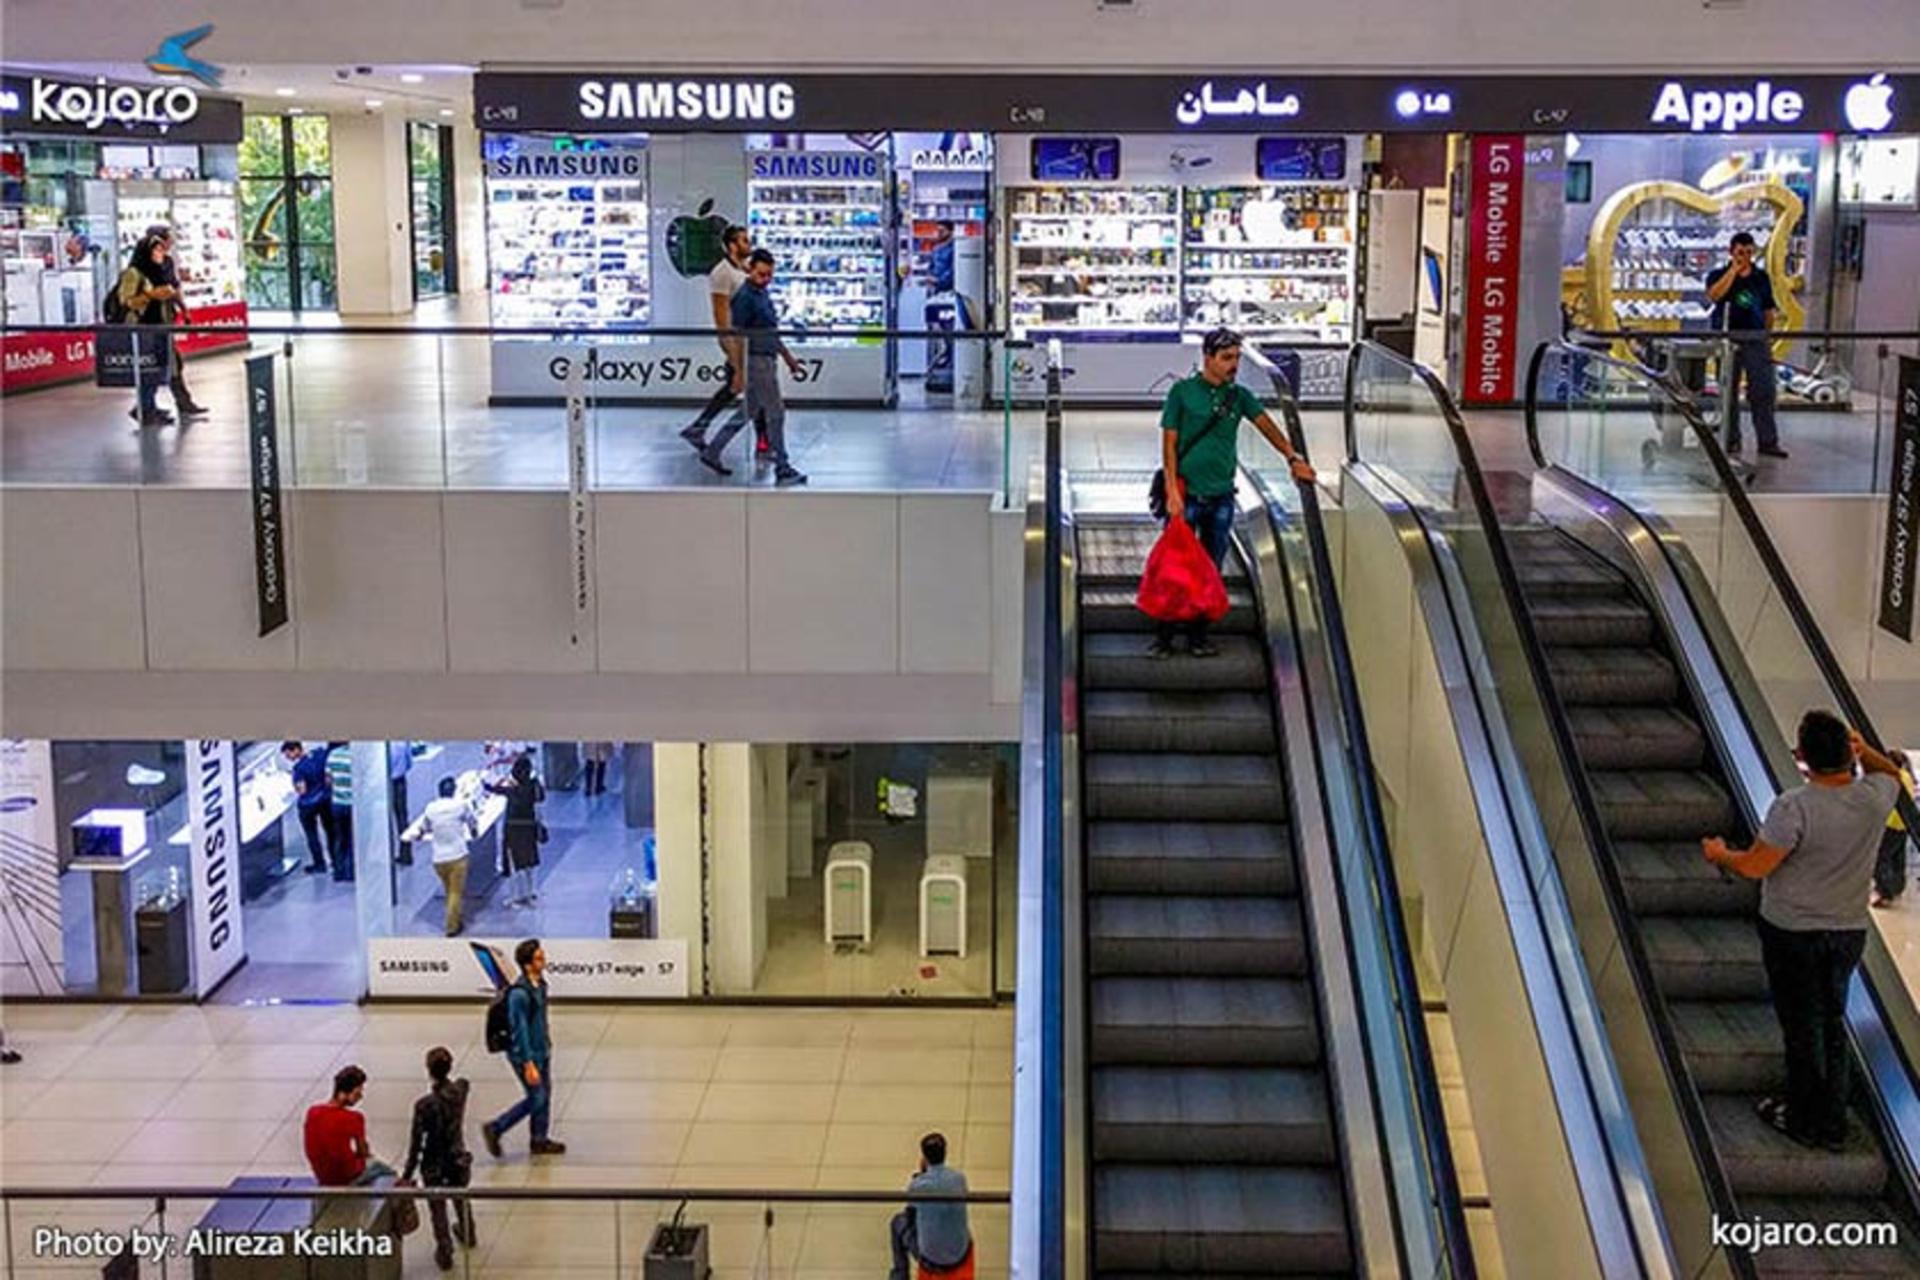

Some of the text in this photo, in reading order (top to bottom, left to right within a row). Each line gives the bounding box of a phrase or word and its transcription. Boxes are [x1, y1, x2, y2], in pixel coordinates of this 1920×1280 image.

[580, 82, 795, 120] SAMSUNG
[1176, 83, 1299, 124] ماهان
[1652, 83, 1803, 131] Apple
[497, 155, 639, 175] SAMSUNG
[754, 156, 877, 176] SAMSUNG
[1480, 144, 1510, 394] LG Mobile LG Mobile
[5, 350, 55, 372] Mobile
[66, 341, 85, 362] LG
[660, 358, 691, 380] S7
[200, 740, 230, 951] SAMSUNG
[380, 960, 450, 973] SAMSUNG
[658, 962, 675, 974] S7
